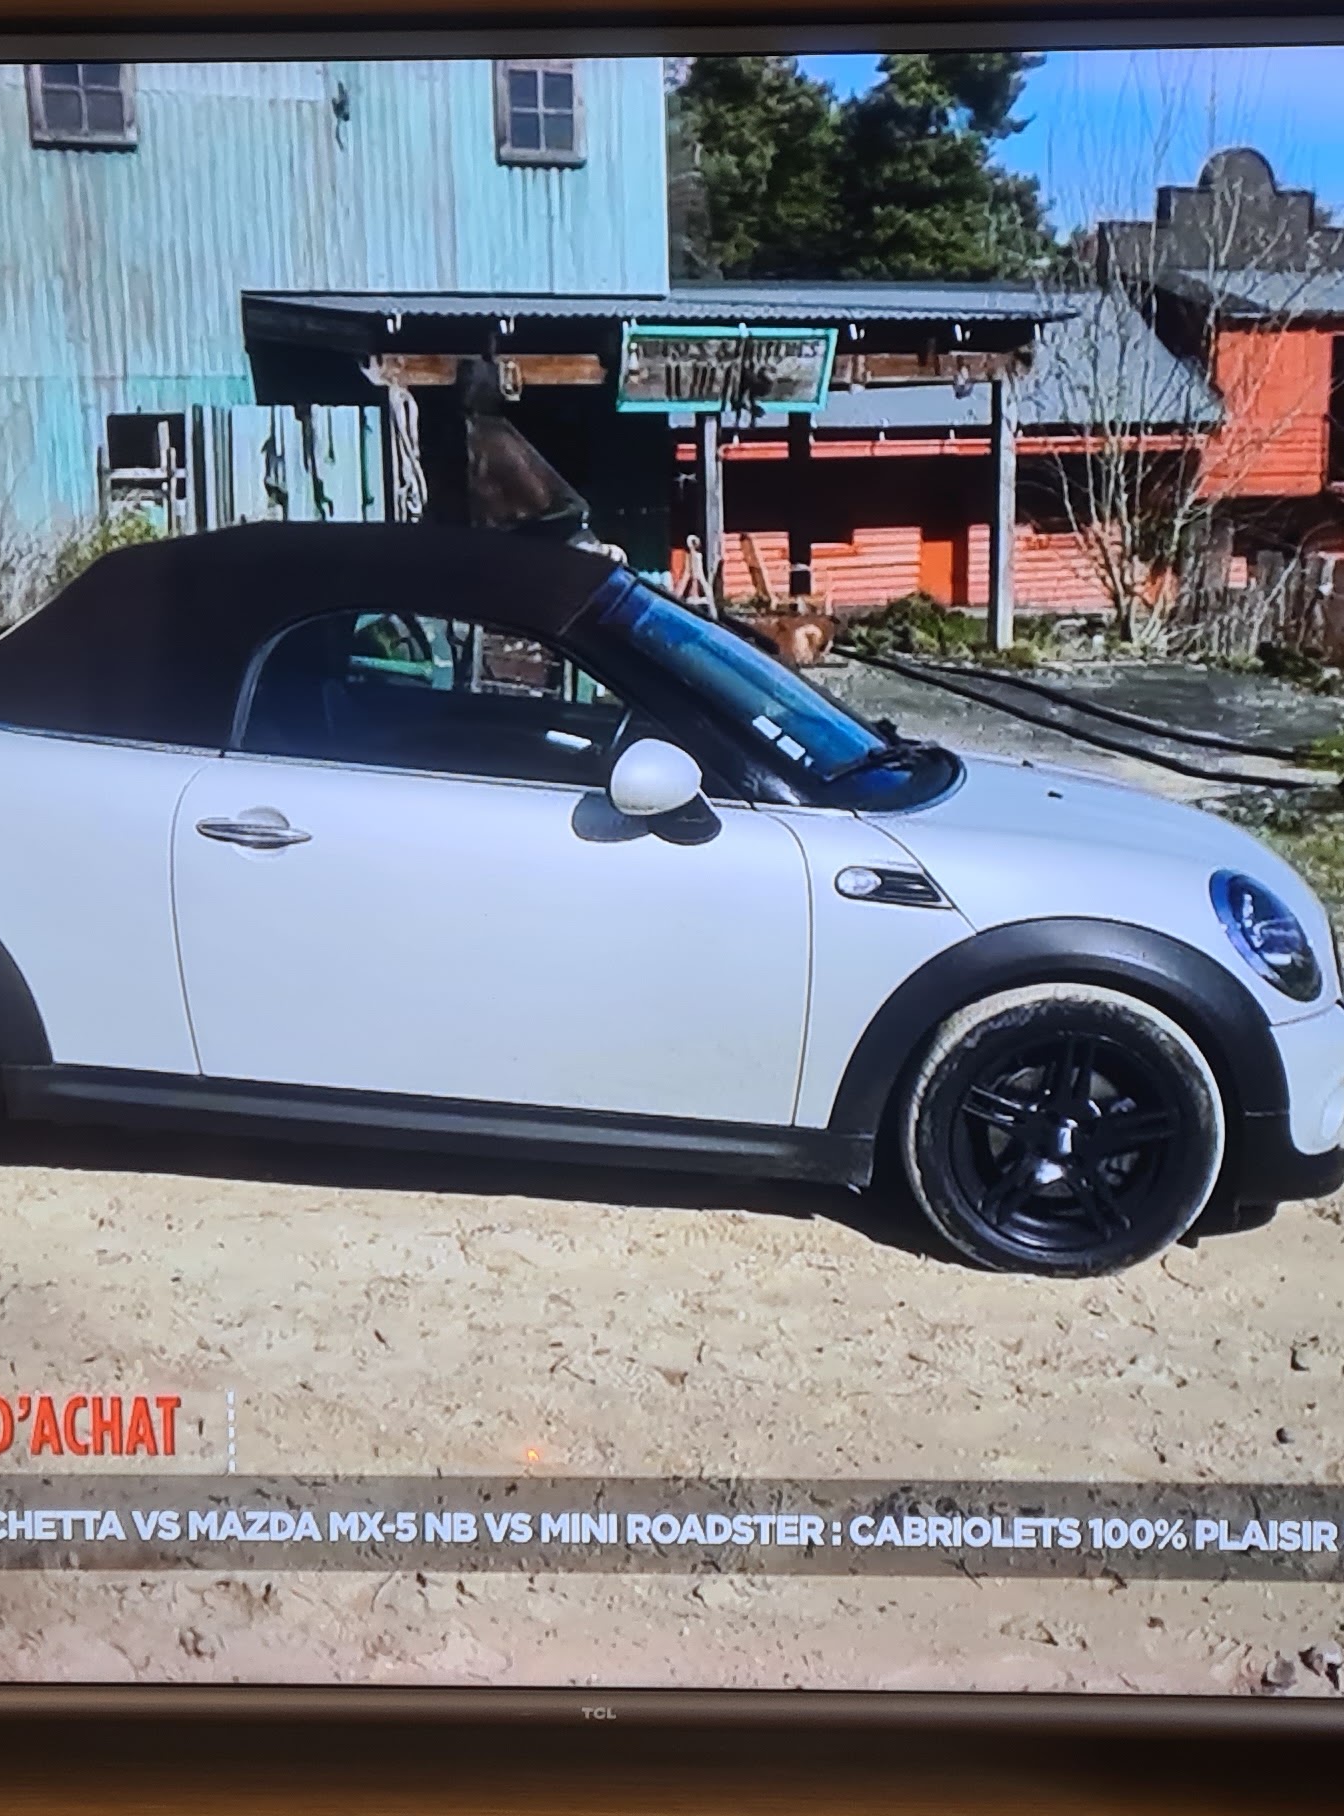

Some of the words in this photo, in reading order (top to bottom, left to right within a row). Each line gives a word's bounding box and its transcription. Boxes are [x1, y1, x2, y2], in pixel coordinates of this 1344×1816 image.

[132, 1509, 182, 1542] VS
[187, 1510, 324, 1543] MAZDA
[328, 1510, 419, 1544] MX-5
[424, 1511, 478, 1544] NB
[482, 1511, 534, 1545] VS
[540, 1512, 619, 1545] MINI
[626, 1513, 825, 1547] ROADSTER
[849, 1515, 1082, 1549] CABRIOLETS
[1088, 1516, 1187, 1551] 100%
[1194, 1518, 1339, 1553] PLAISIR
[581, 1706, 617, 1720] TCL
